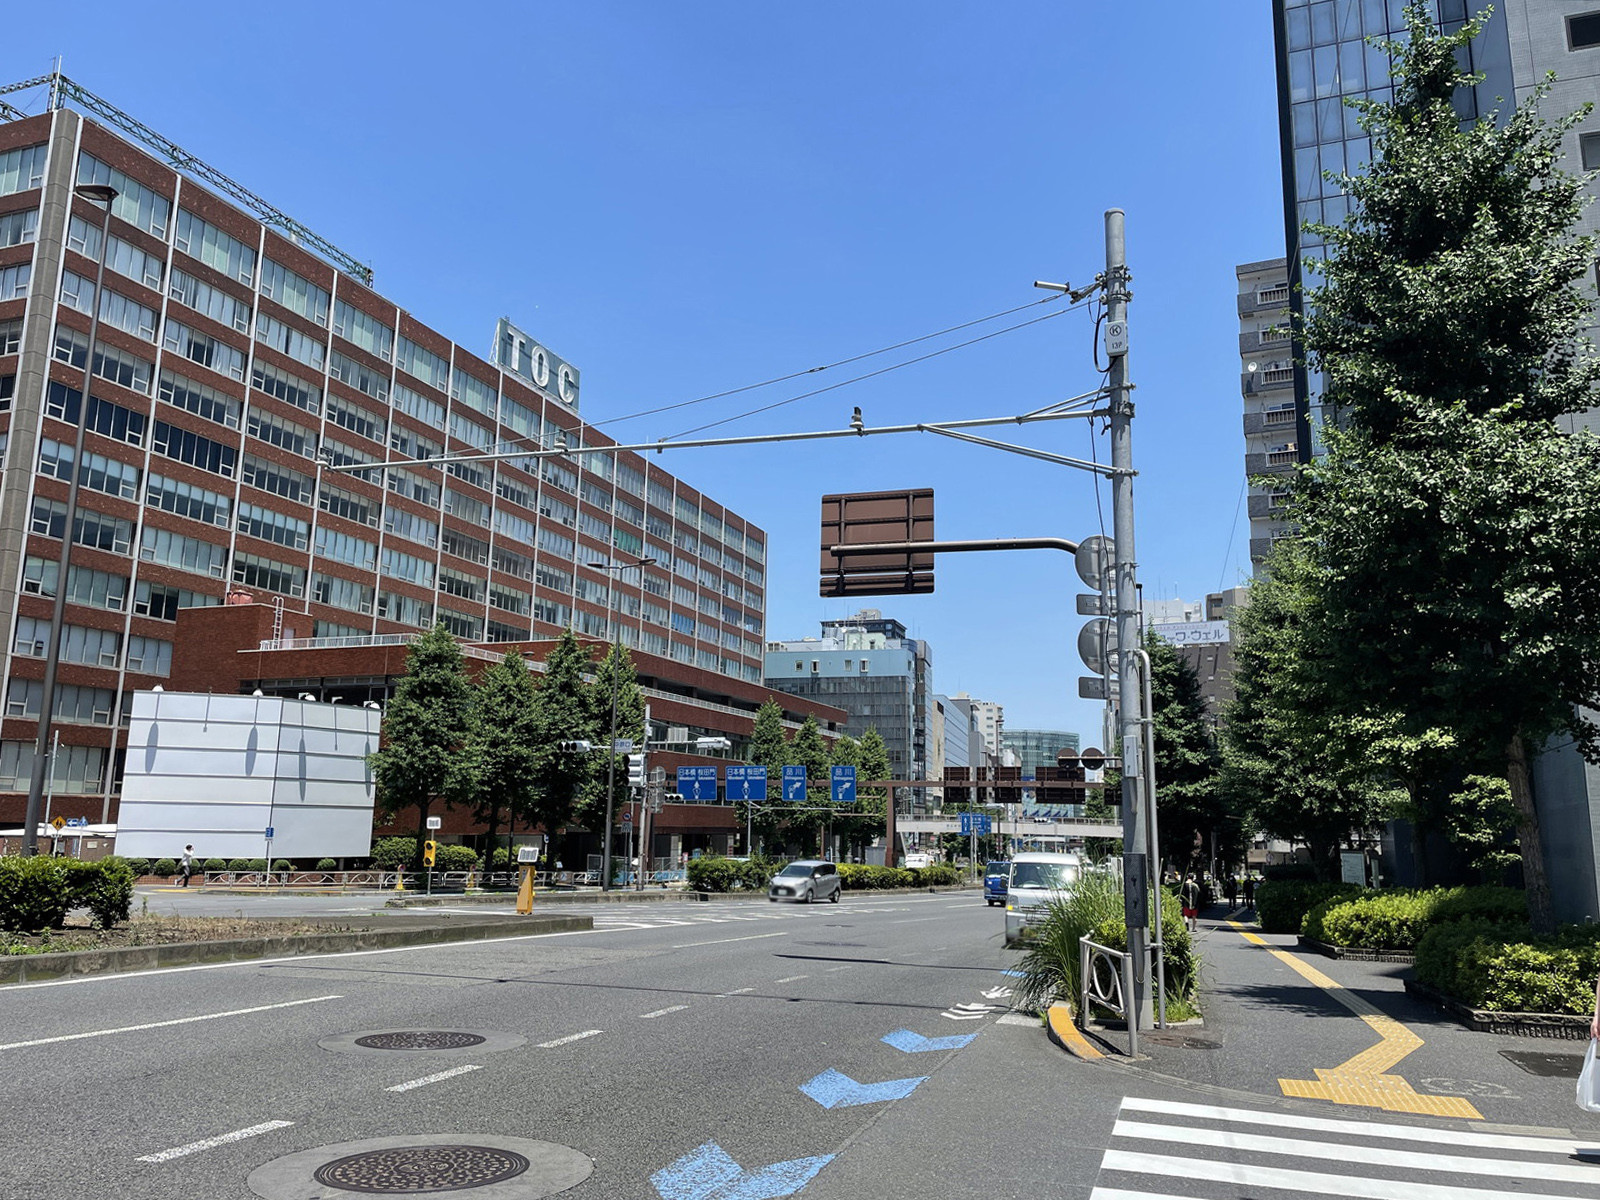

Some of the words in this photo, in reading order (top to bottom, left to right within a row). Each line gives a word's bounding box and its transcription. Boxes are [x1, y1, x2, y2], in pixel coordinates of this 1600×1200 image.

[507, 326, 575, 404] TOC
[786, 768, 802, 776] 品川
[835, 768, 852, 776] 品川
